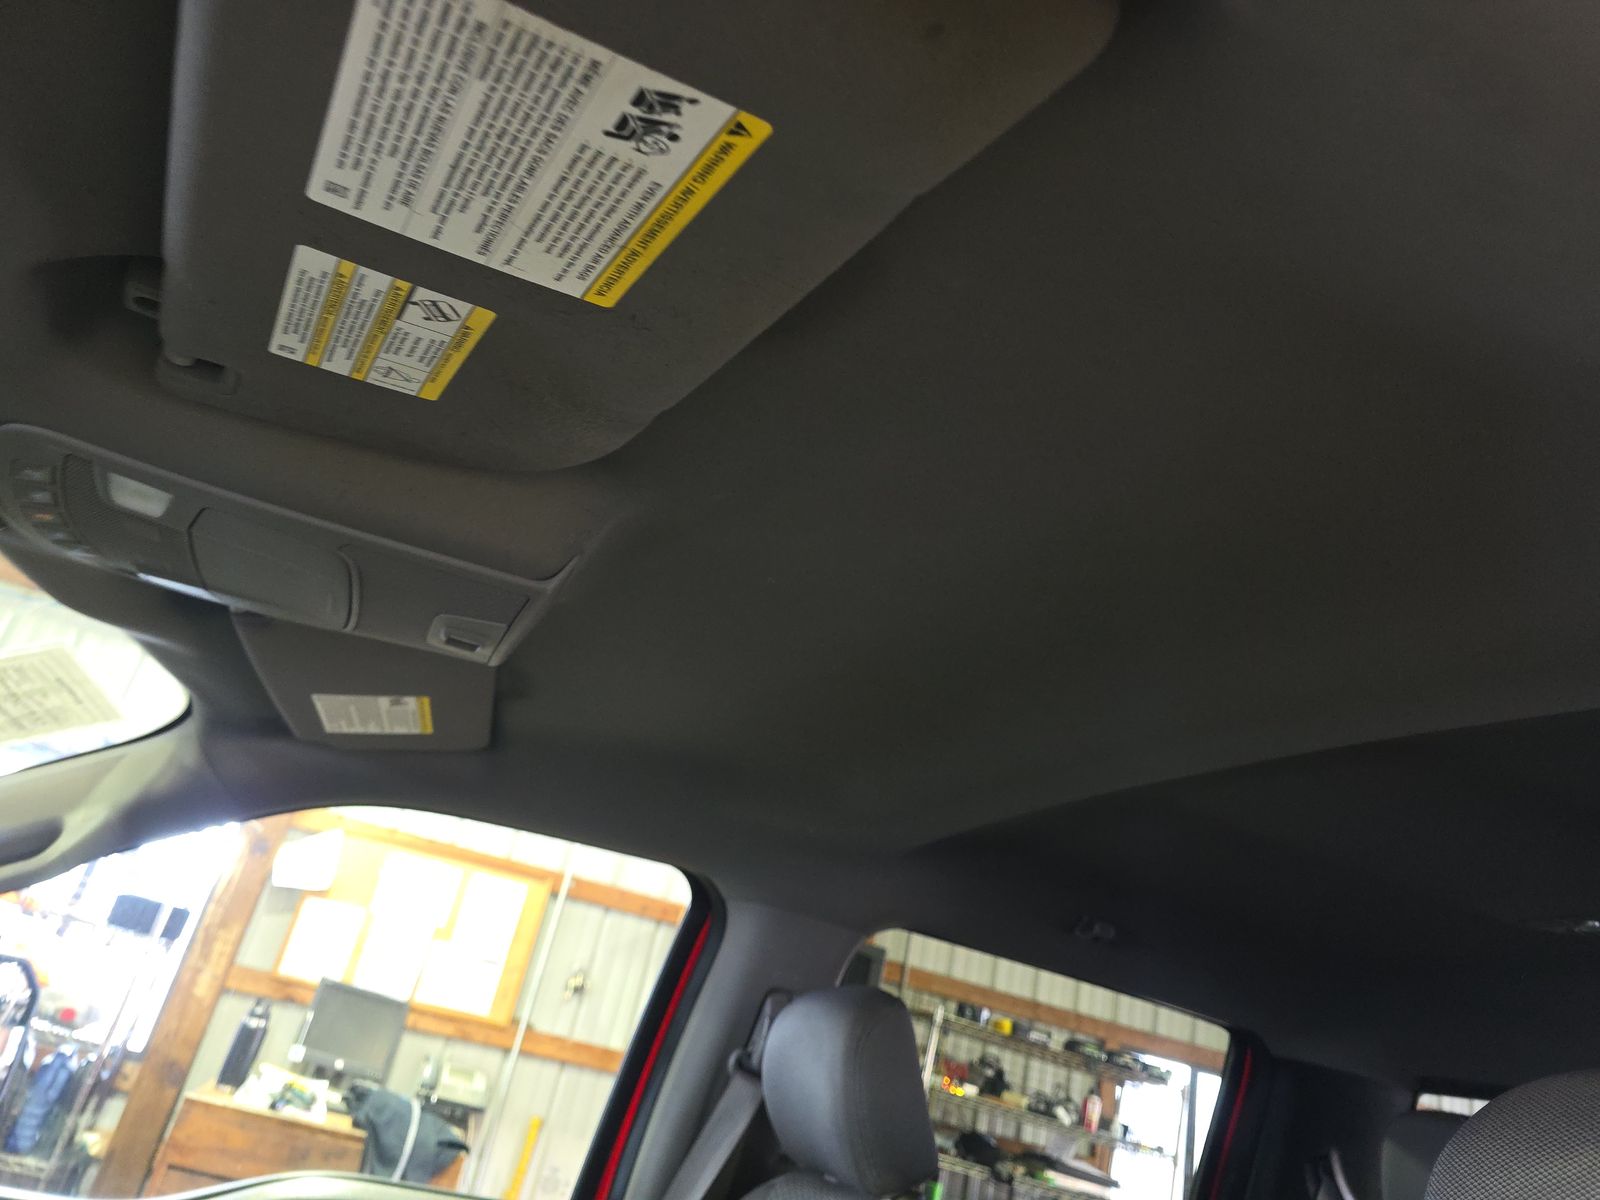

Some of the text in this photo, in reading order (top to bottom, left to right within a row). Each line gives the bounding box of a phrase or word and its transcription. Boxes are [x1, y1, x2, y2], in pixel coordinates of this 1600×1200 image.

[689, 139, 738, 185] WARNING
[574, 180, 663, 282] EVEN WITH ADVANCED AIR BAGS
